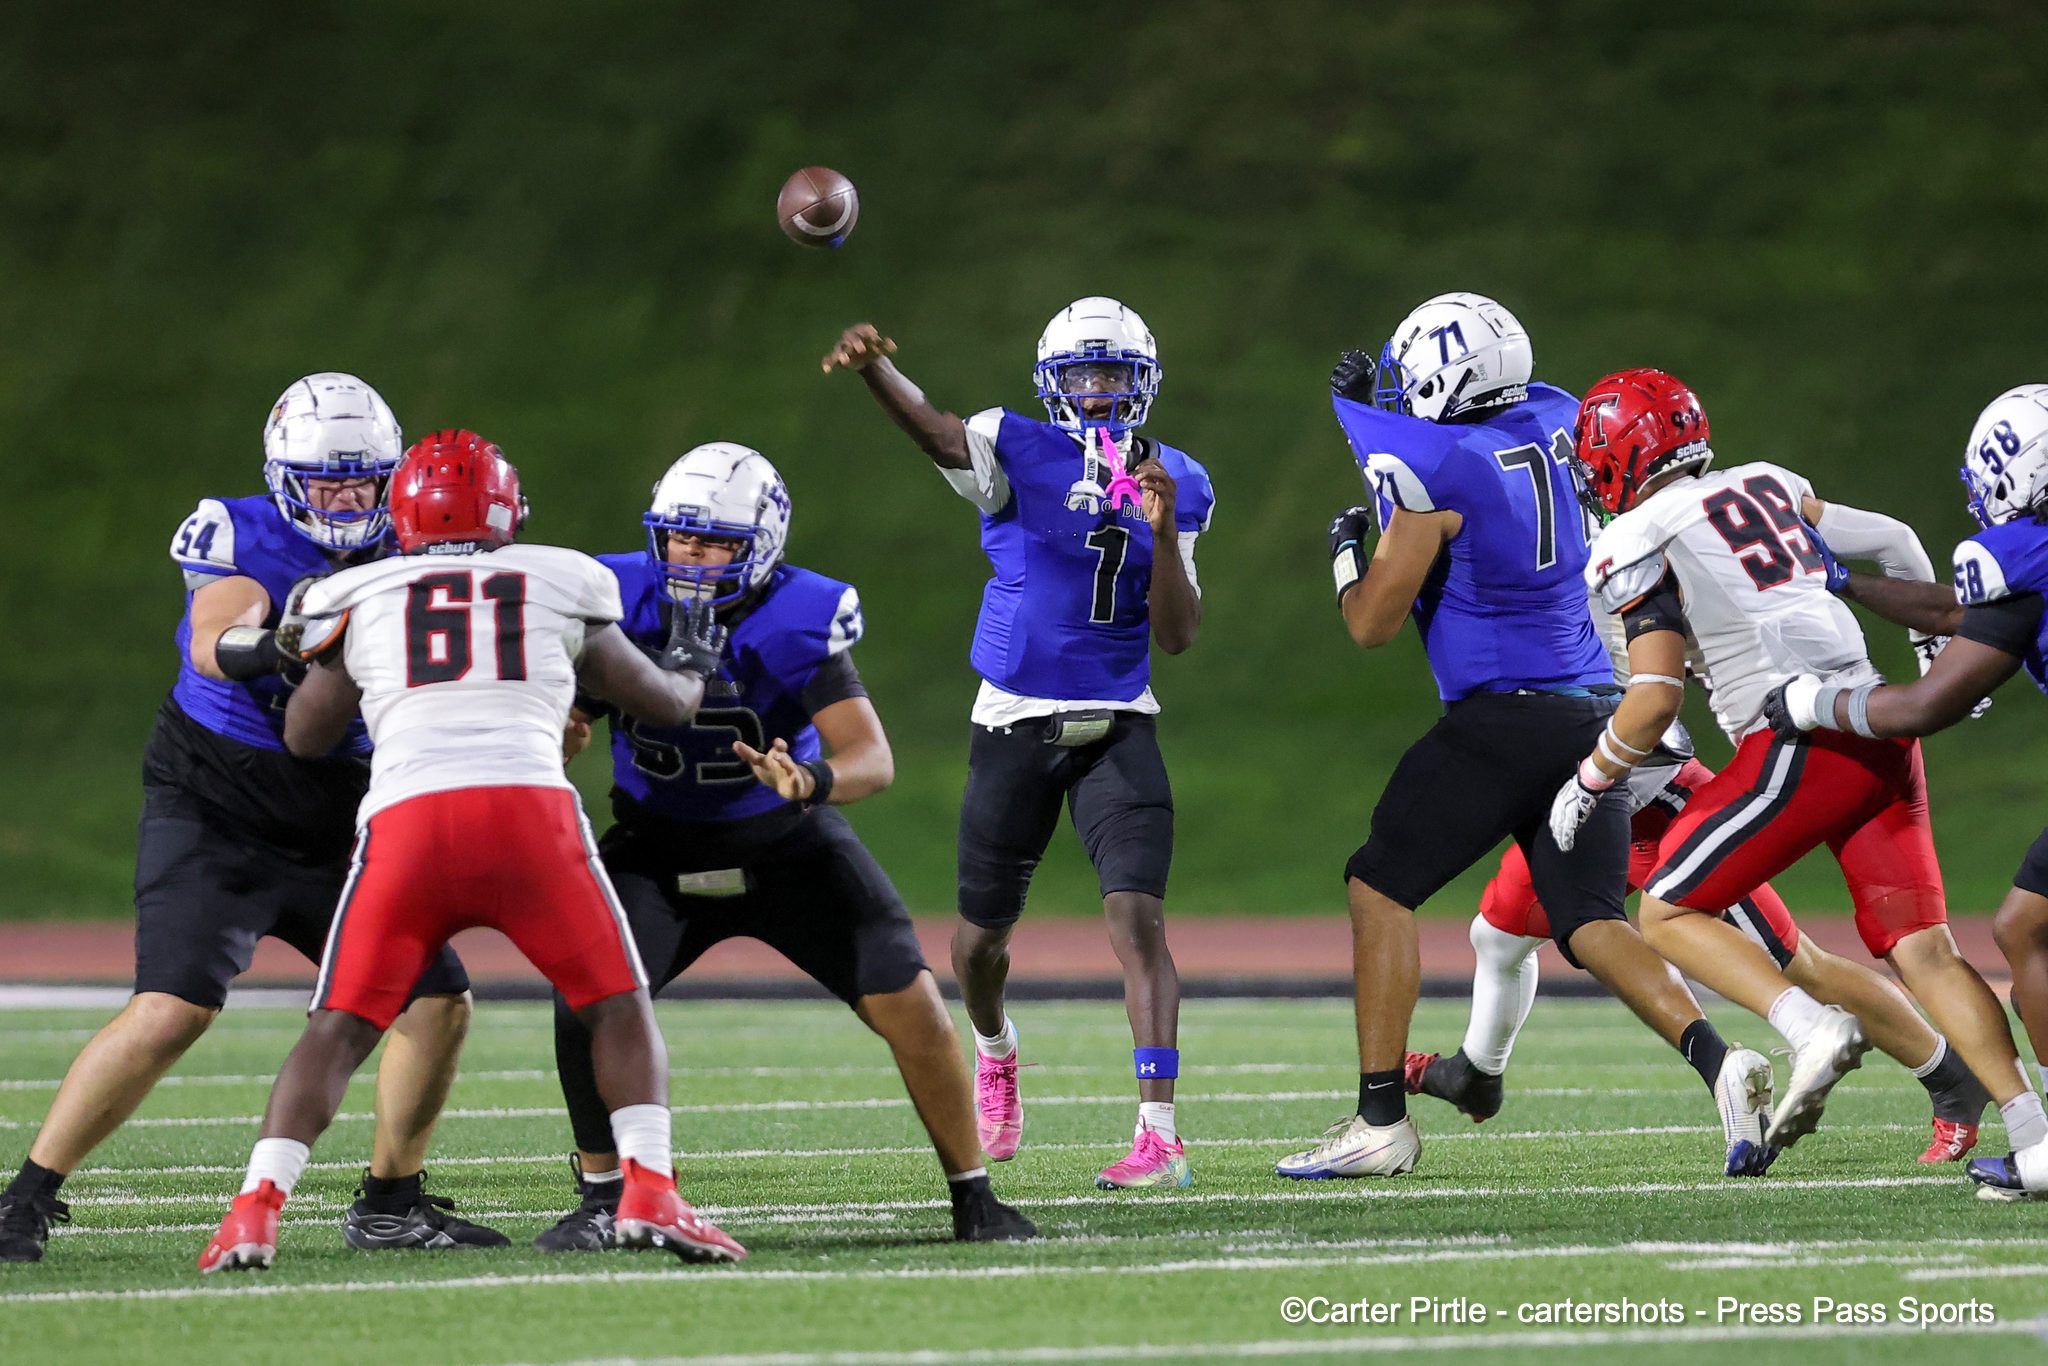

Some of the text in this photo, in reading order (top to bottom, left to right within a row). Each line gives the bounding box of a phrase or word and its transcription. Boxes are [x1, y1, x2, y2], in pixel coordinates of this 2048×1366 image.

[1429, 320, 1469, 366] 71
[1583, 393, 1621, 449] T
[1979, 419, 2021, 475] 58
[1493, 426, 1592, 572] 71
[177, 518, 219, 560] 54
[1084, 525, 1130, 624] 1
[1954, 558, 1985, 604] 58
[405, 570, 526, 688] 61
